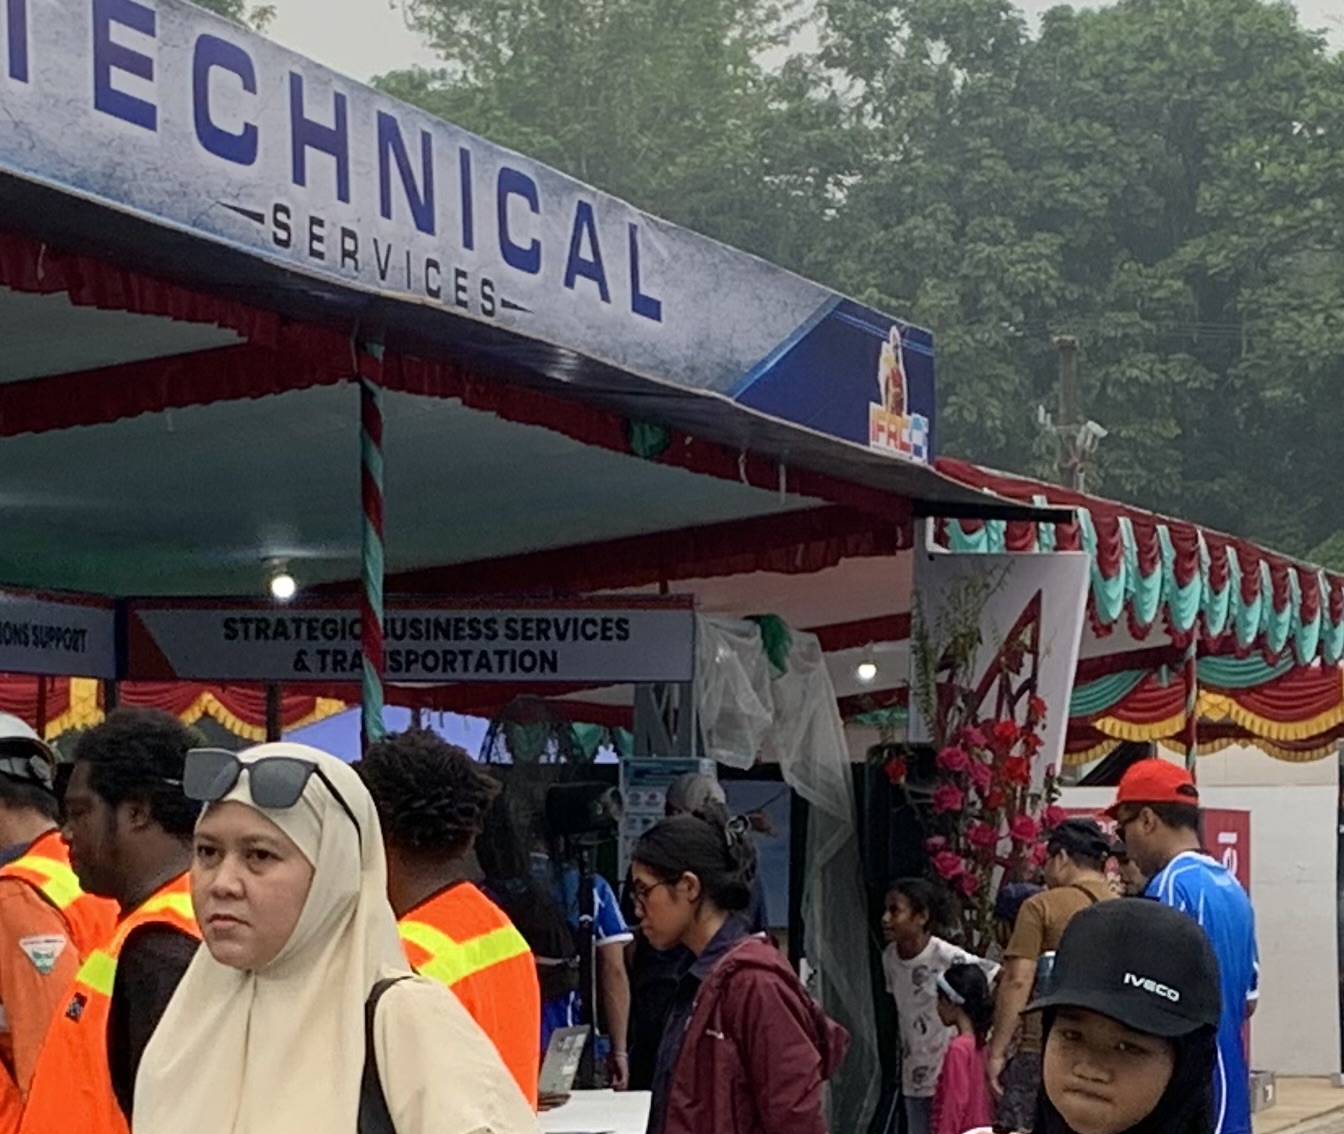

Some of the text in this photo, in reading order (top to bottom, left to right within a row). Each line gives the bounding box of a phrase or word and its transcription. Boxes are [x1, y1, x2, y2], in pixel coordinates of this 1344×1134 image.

[271, 203, 498, 318] SERVICES
[30, 622, 88, 653] SUPPORT
[382, 616, 499, 643] USINESS
[503, 615, 631, 643] SERVICES
[292, 648, 560, 674] & TRASPORTATION
[1123, 972, 1180, 1002] IVECO
